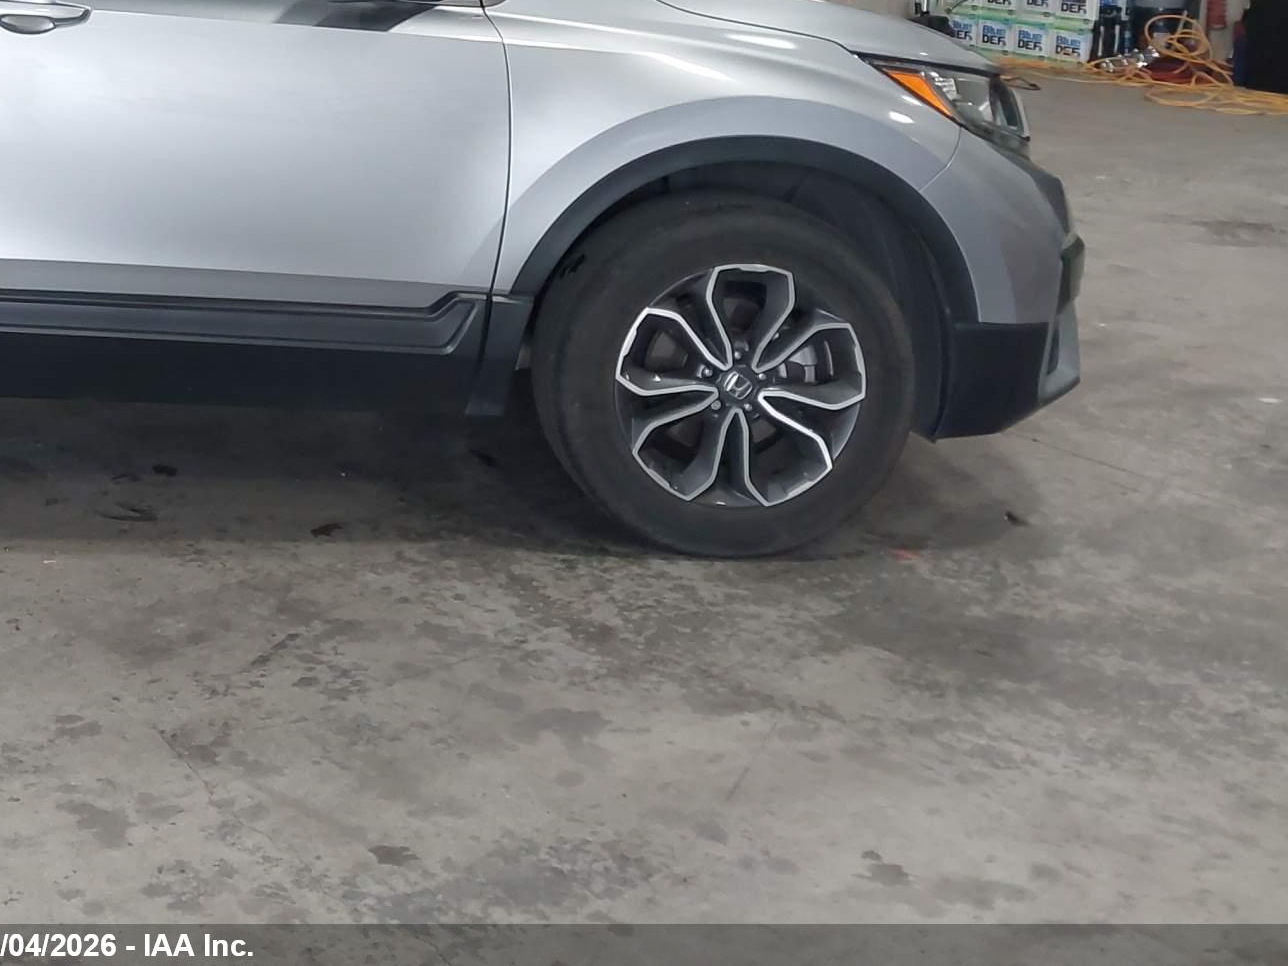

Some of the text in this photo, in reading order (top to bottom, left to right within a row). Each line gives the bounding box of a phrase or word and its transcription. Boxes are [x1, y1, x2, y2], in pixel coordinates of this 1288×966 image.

[1061, 2, 1087, 14] DEF
[957, 30, 972, 40] EF
[983, 25, 1006, 35] Blue
[1018, 30, 1042, 41] Blue
[982, 34, 1006, 45] DEF
[1018, 39, 1042, 51] DEF
[1056, 35, 1080, 45] Blue
